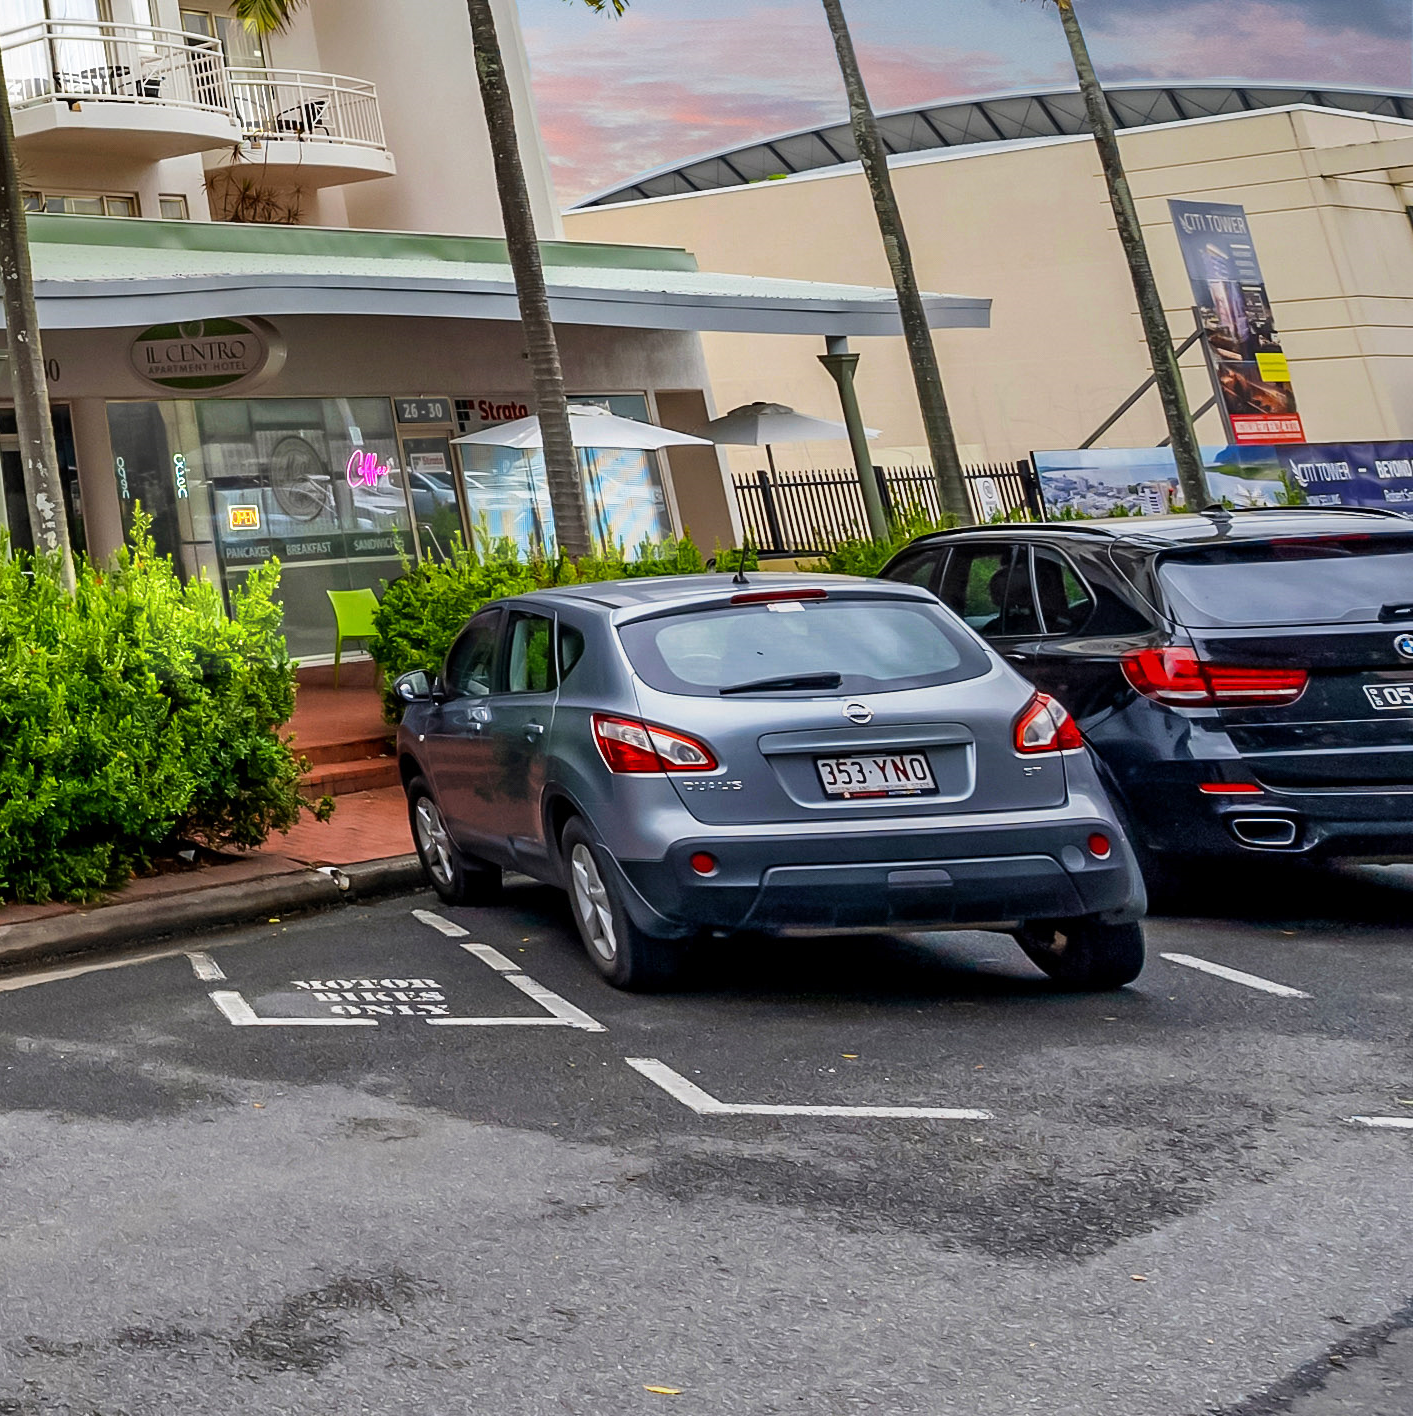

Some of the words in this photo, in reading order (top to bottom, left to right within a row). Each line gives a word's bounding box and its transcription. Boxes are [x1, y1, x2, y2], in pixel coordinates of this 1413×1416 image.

[1206, 215, 1247, 234] TOWER
[146, 347, 162, 363] IL
[166, 340, 246, 362] CENTRO
[148, 363, 207, 374] APARTMENT
[213, 360, 248, 370] HOTEL
[403, 403, 418, 418] 26
[428, 403, 443, 418] 30
[478, 400, 529, 420] Strata
[346, 449, 390, 488] Coffee
[1314, 462, 1351, 481] TOWER
[1375, 460, 1413, 479] BEYOND
[232, 510, 257, 525] OPEN
[226, 545, 271, 559] PANCAKES
[286, 542, 332, 556] BREAKFAST
[290, 978, 443, 990] MOTOR
[312, 991, 446, 1002] BIKES
[330, 1004, 450, 1015] ONLY
